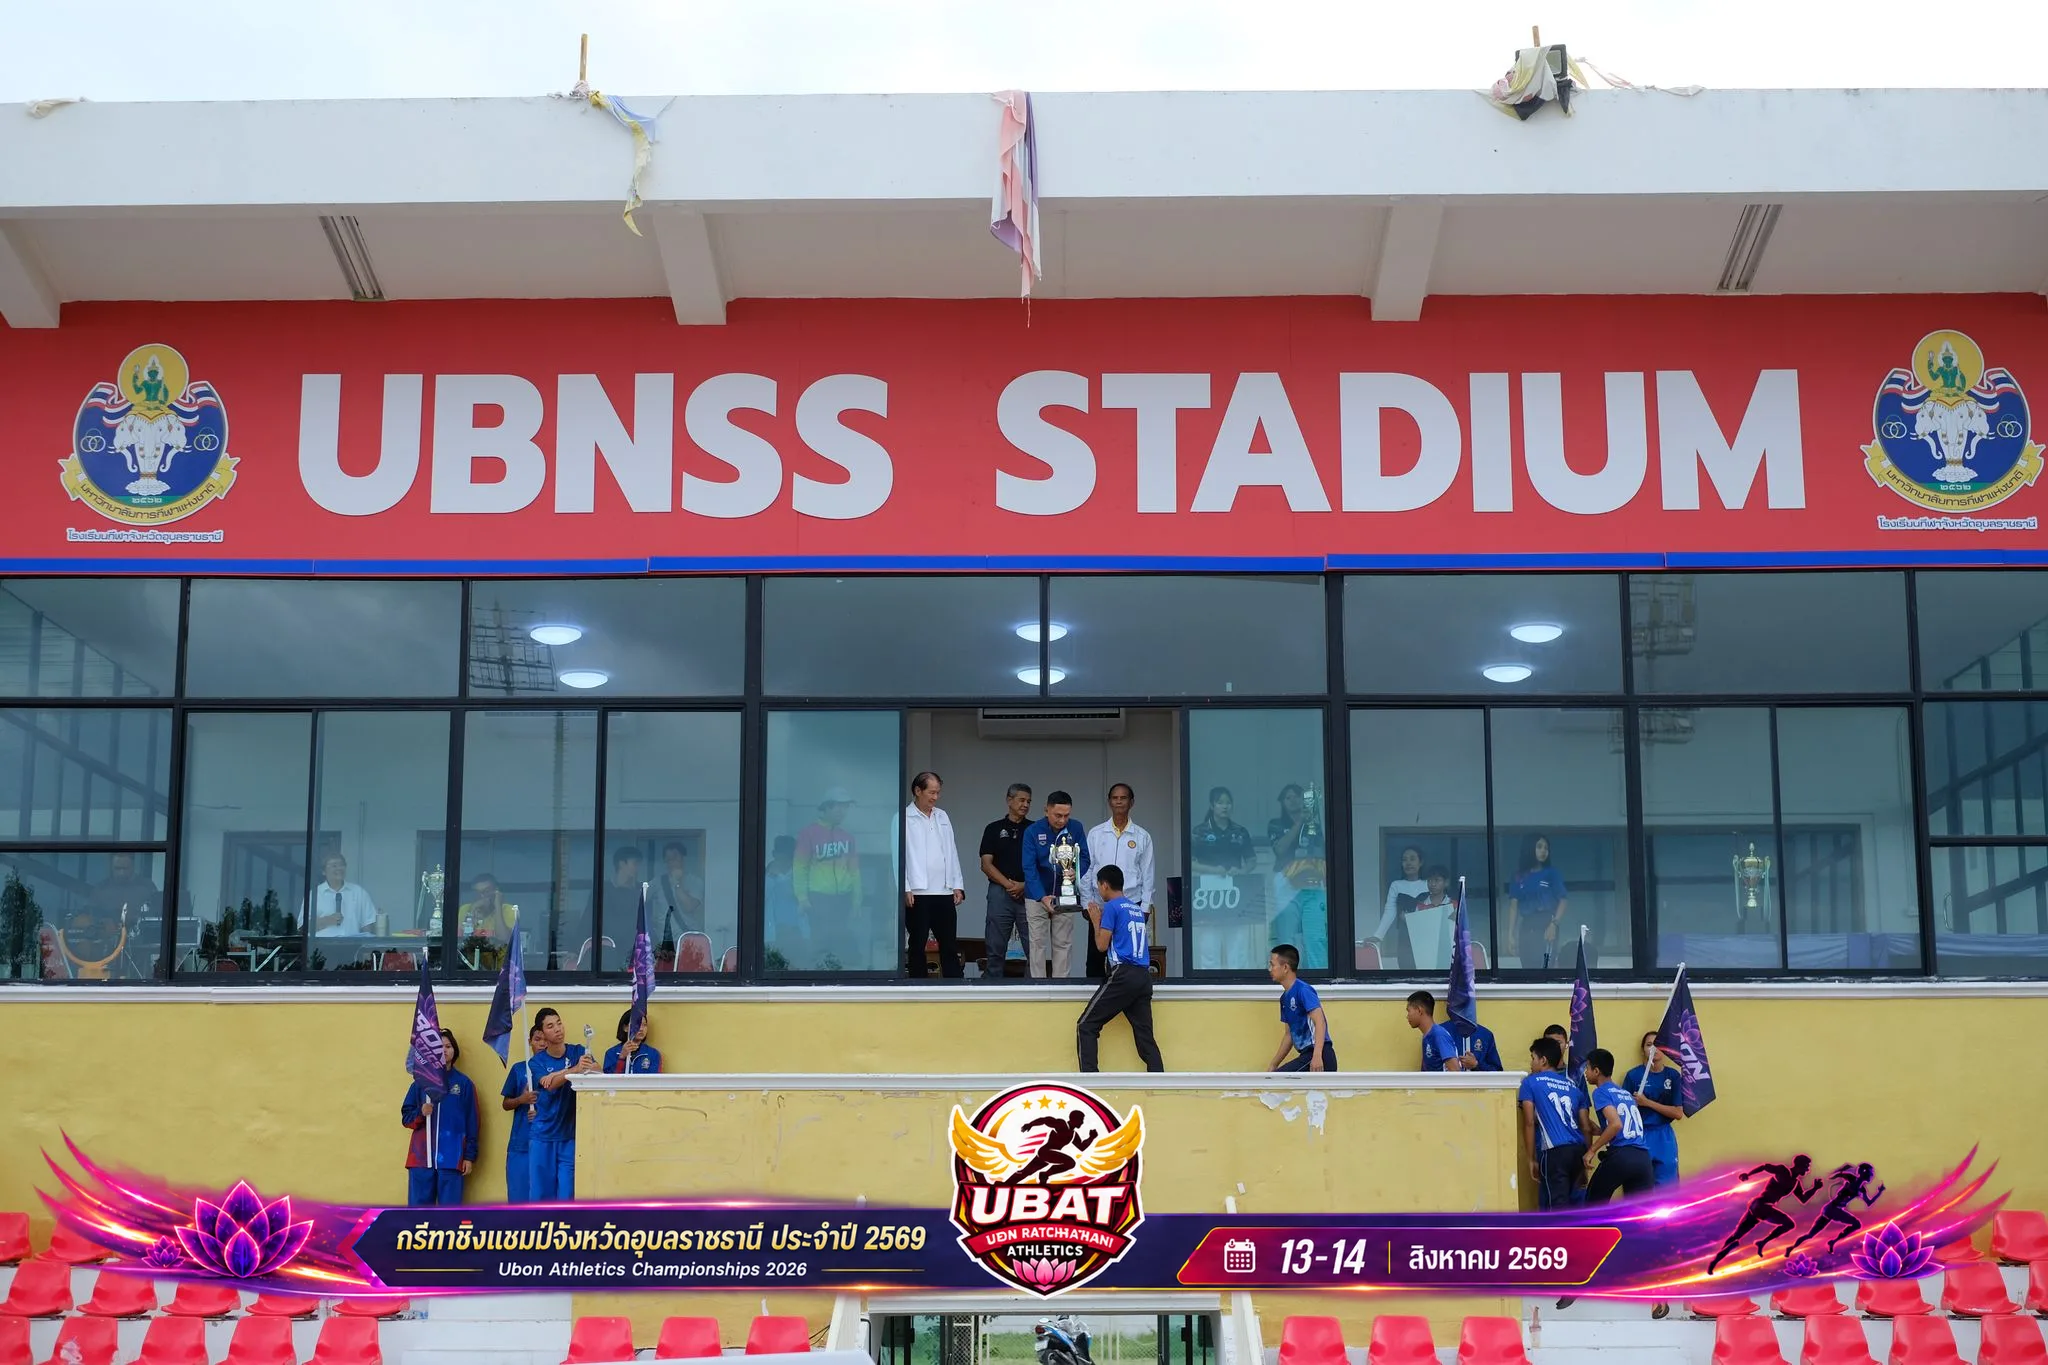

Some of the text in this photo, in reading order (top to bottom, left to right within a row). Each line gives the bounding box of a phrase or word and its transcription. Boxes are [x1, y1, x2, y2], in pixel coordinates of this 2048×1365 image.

[299, 369, 1806, 520] UBNSS STADIUM
[1192, 886, 1240, 911] 800
